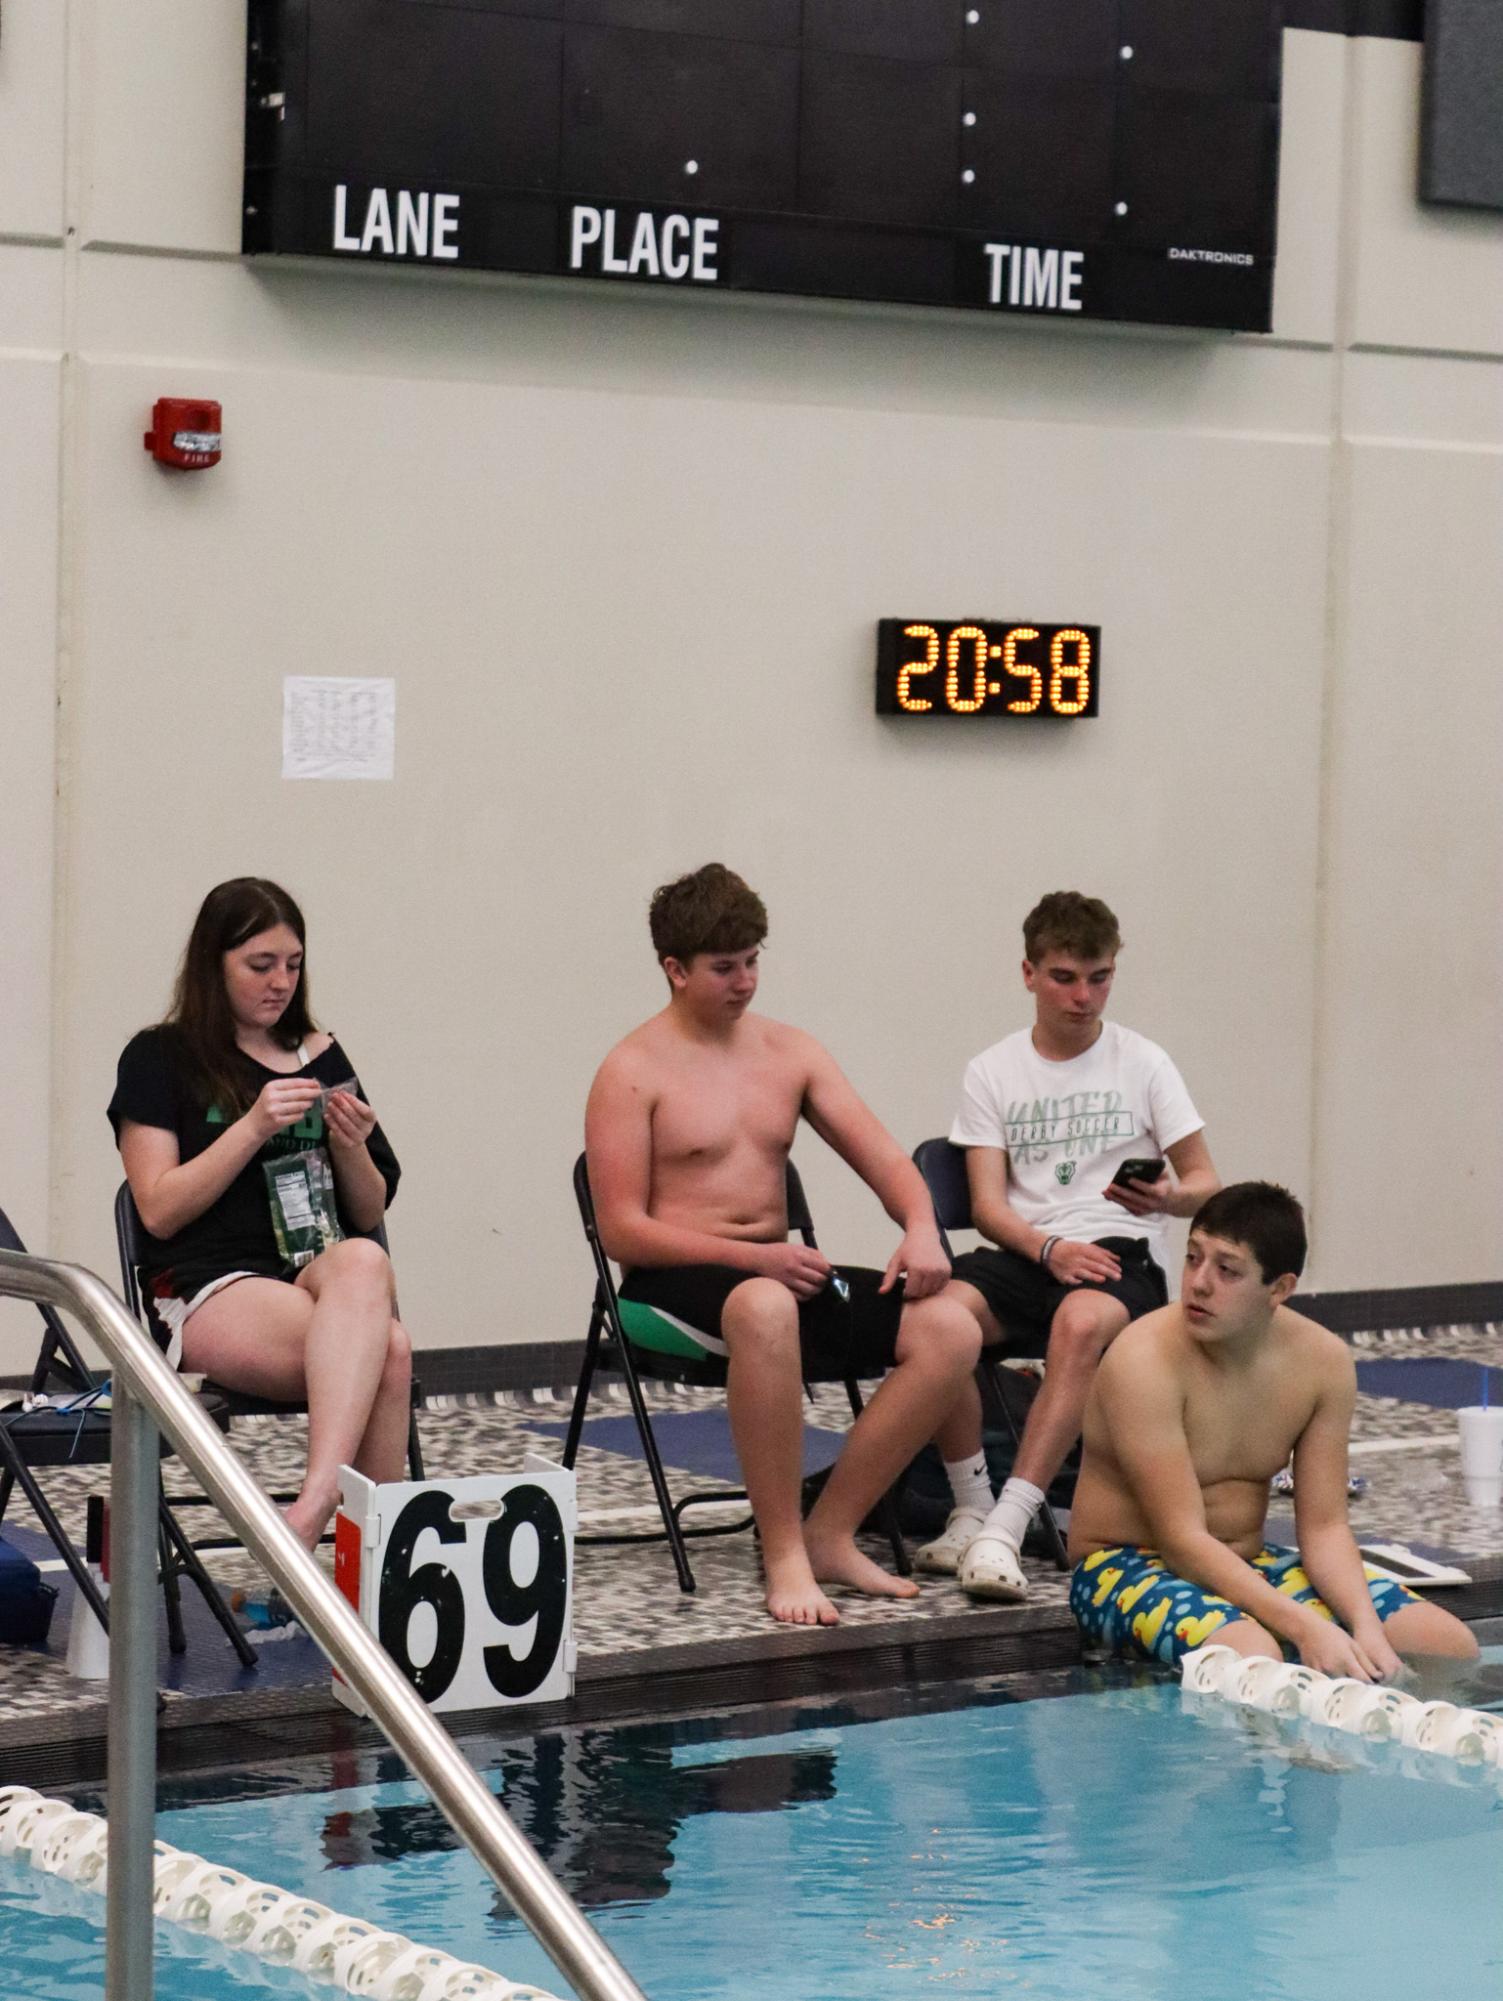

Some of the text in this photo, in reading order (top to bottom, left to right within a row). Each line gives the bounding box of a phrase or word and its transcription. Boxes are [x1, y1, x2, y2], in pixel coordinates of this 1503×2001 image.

[333, 184, 1084, 311] LANE PLACE TIME
[1168, 247, 1254, 266] DAKTRONICS
[183, 454, 209, 464] FIRE
[897, 624, 1090, 714] 20:58
[1008, 1090, 1121, 1124] UNITED
[1011, 1116, 1120, 1142] DERBY SOCCER
[1014, 1137, 1048, 1165] AS
[378, 1484, 568, 1705] 69
